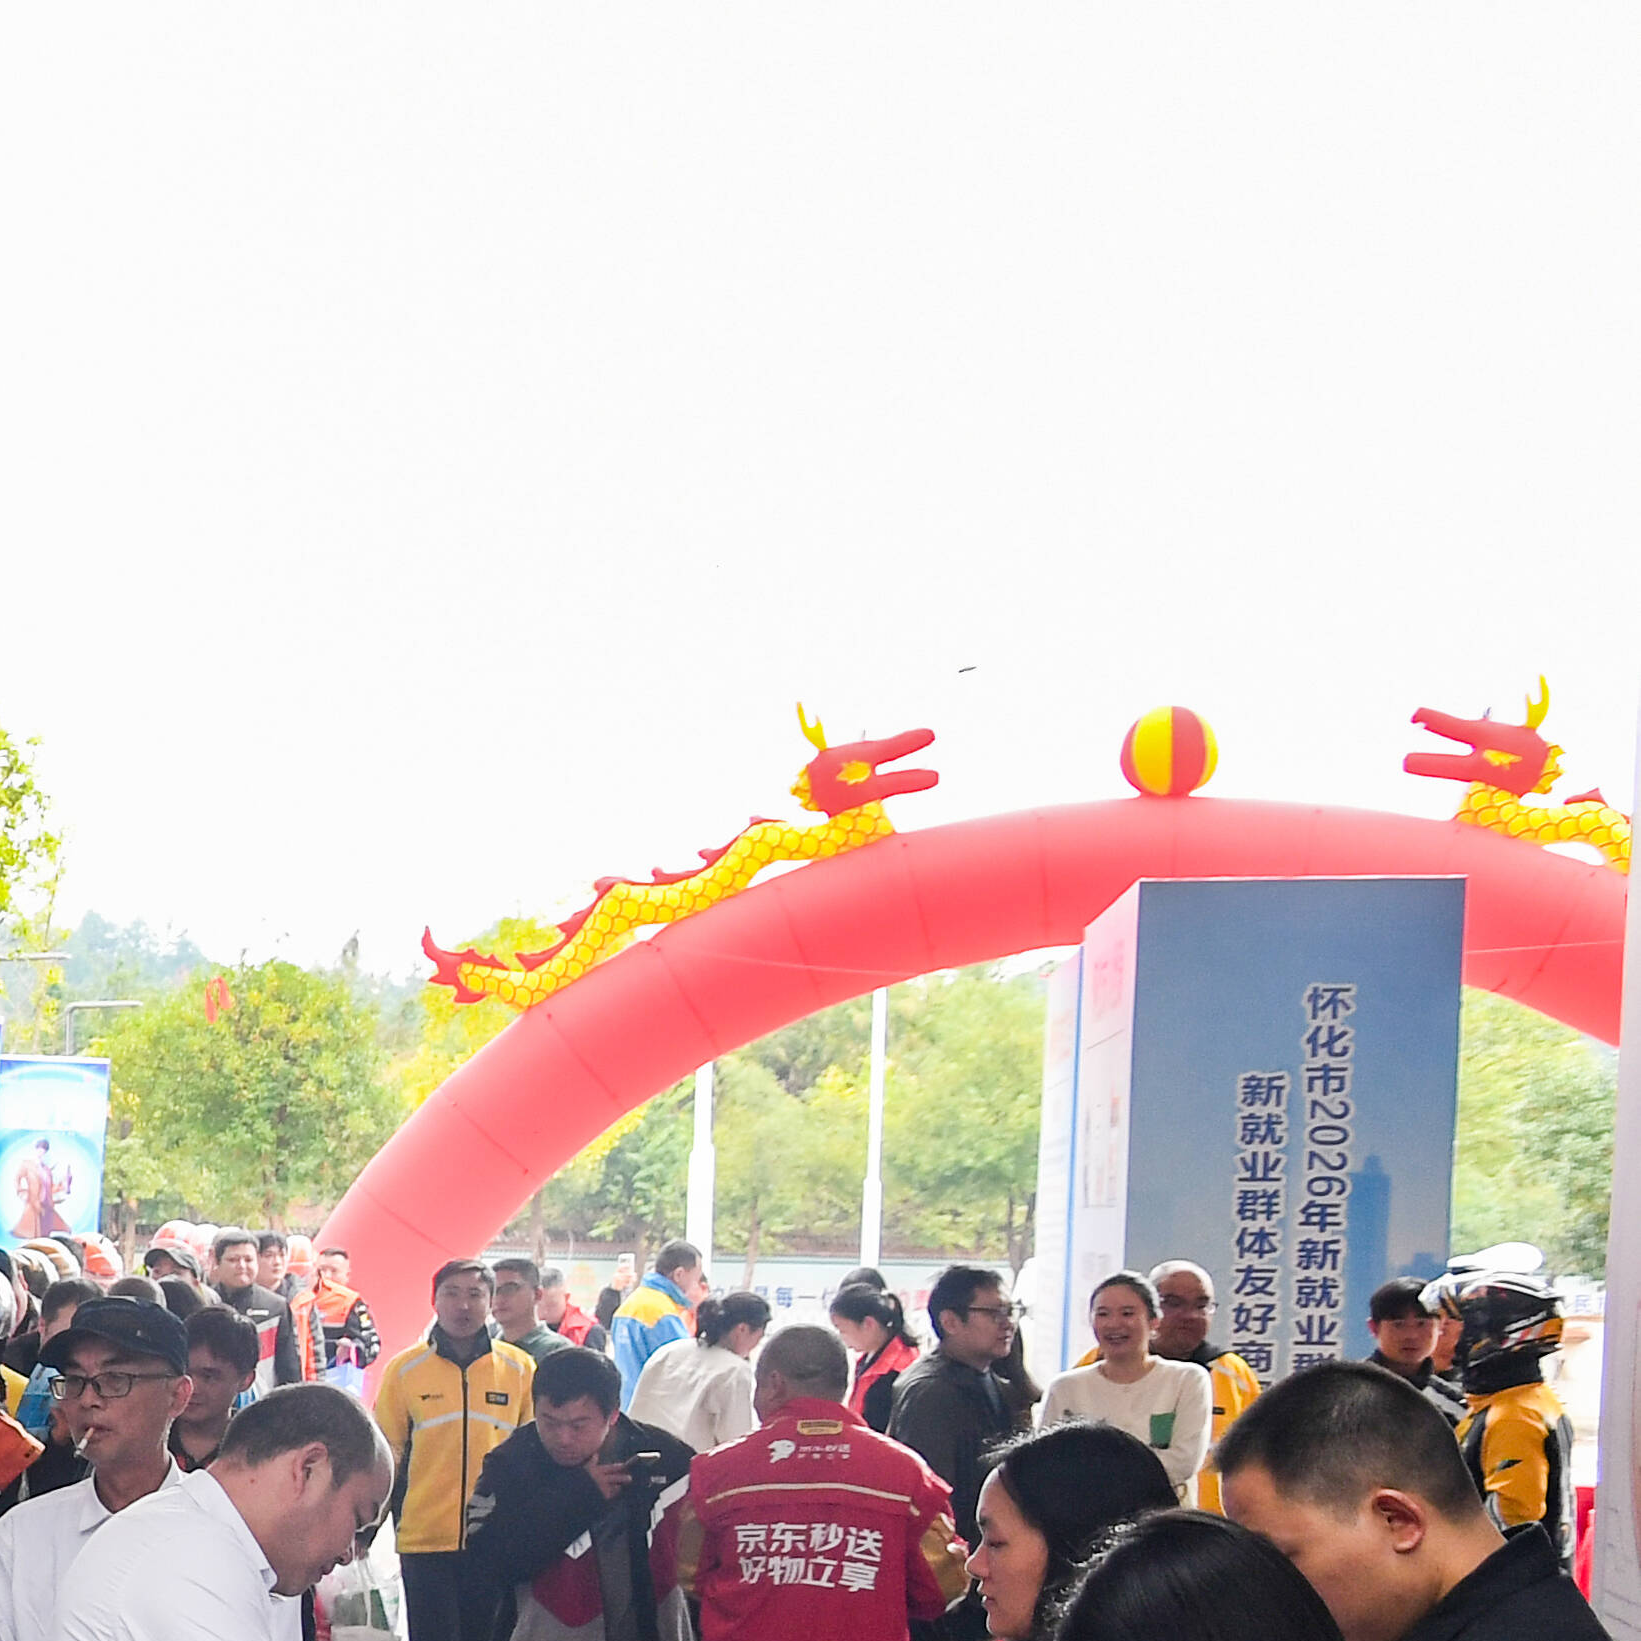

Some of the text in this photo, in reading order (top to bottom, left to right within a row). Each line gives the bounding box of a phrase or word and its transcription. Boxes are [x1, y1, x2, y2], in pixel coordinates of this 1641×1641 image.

[1231, 1075, 1285, 1387] 新就业群体友好商
[734, 1522, 884, 1563] 京东秒送
[739, 1556, 880, 1594] 好物立享
